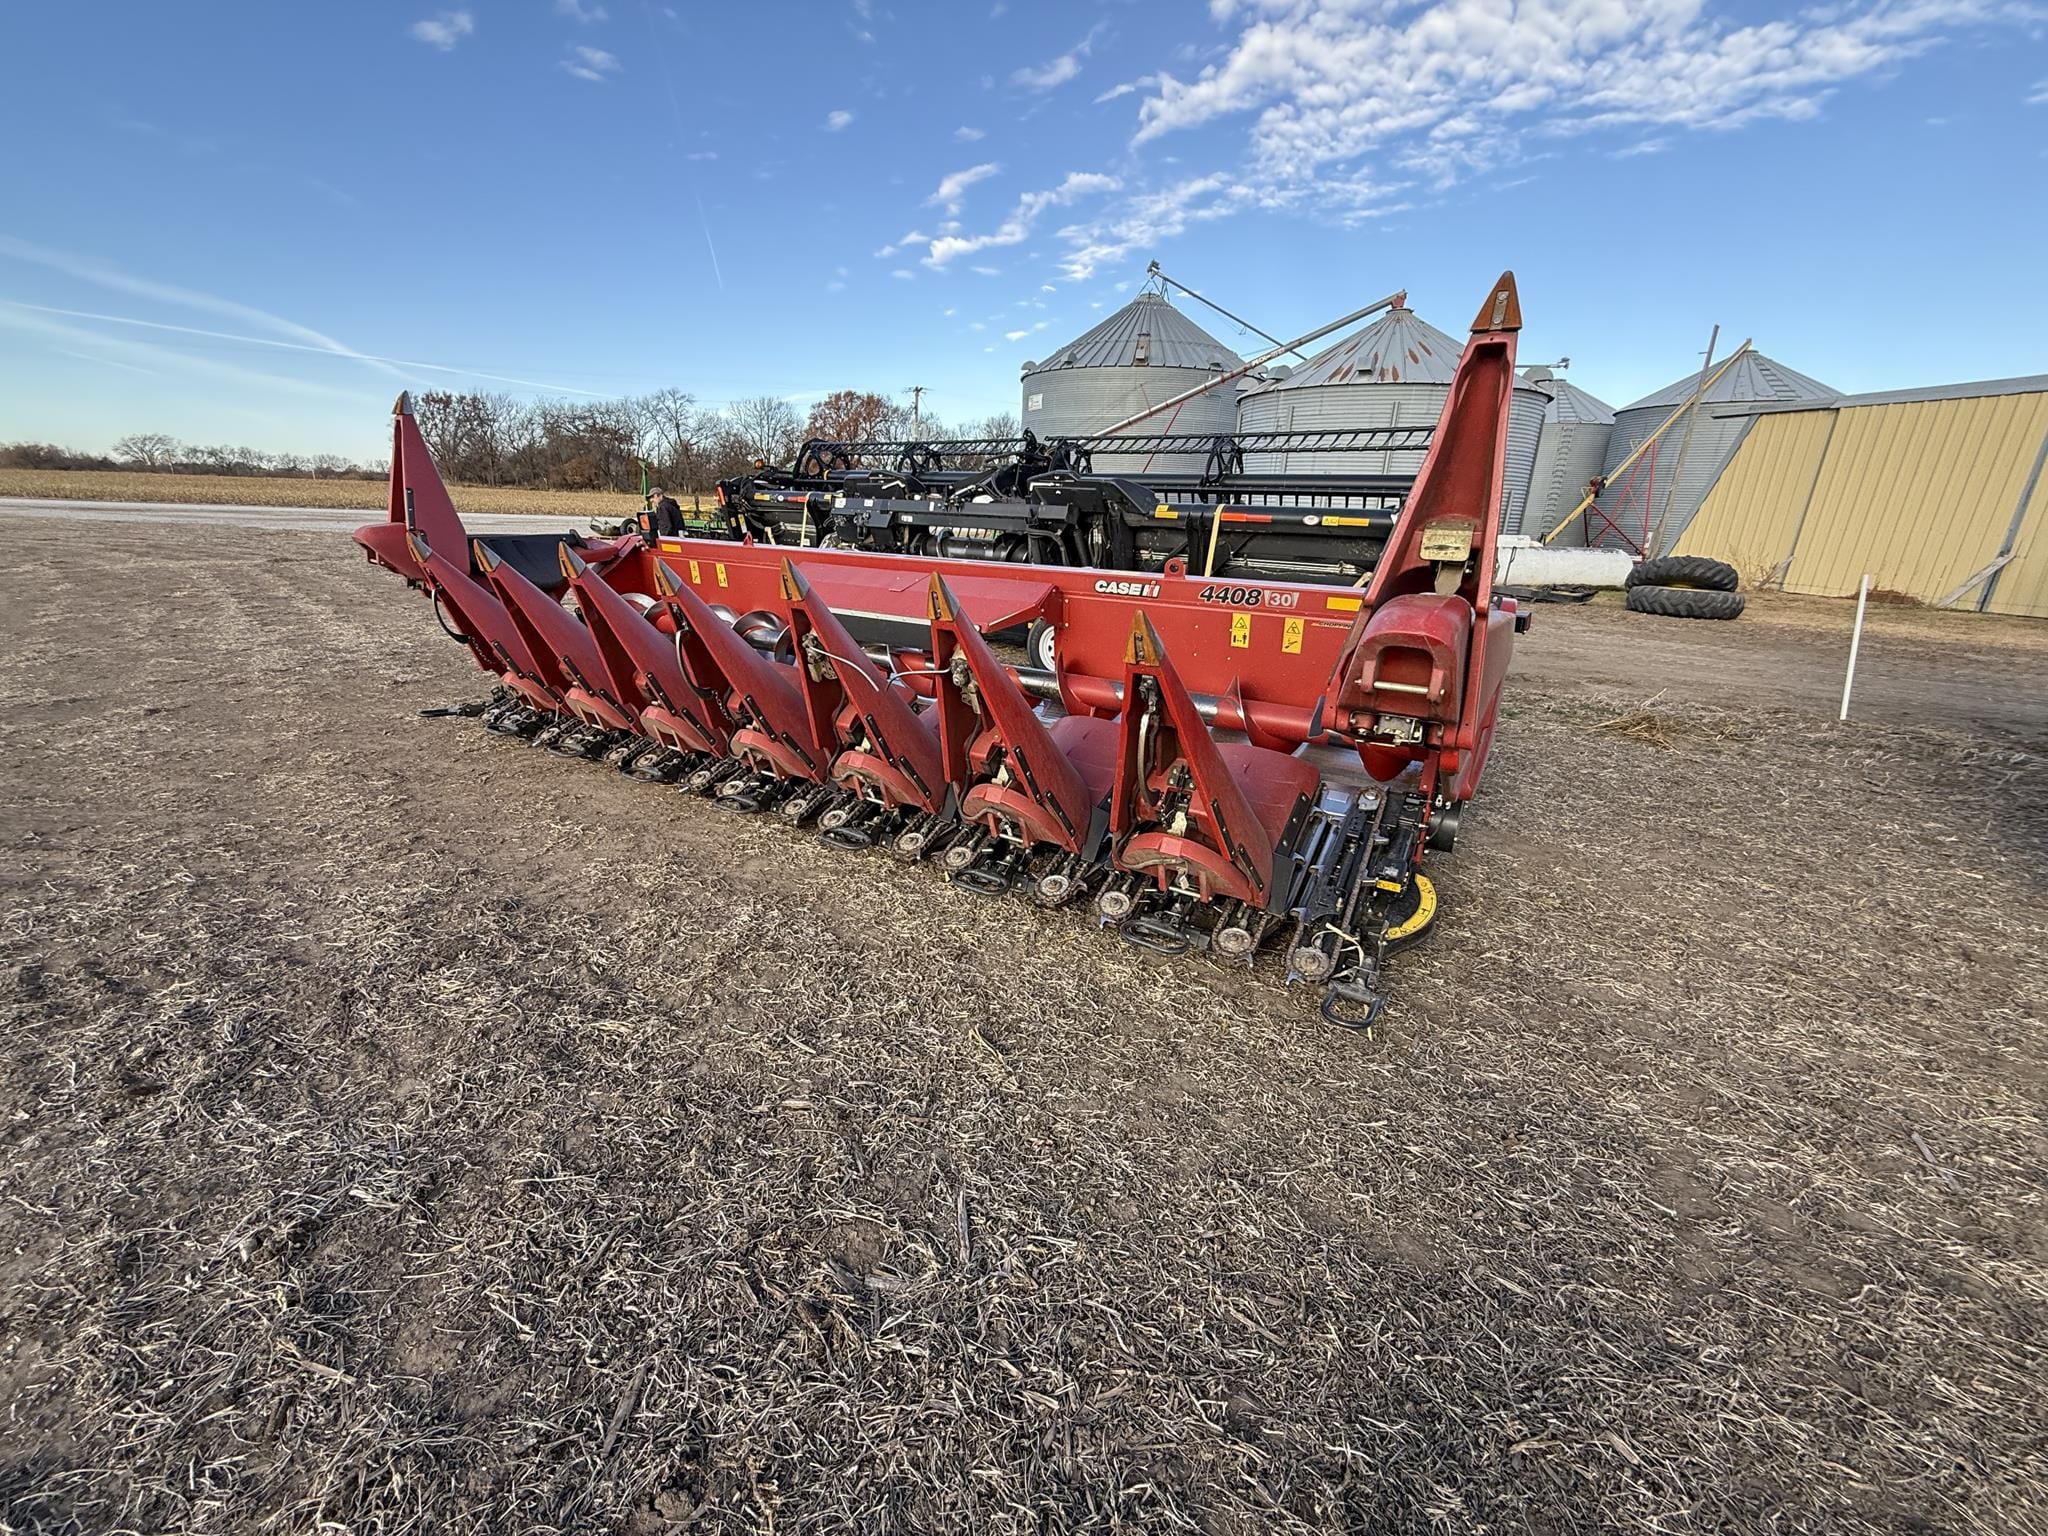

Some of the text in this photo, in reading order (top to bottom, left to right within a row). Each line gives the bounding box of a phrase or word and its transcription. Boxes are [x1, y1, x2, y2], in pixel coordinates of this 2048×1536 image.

[1094, 579, 1142, 597] CASE
[1199, 585, 1292, 607] 4408 30
